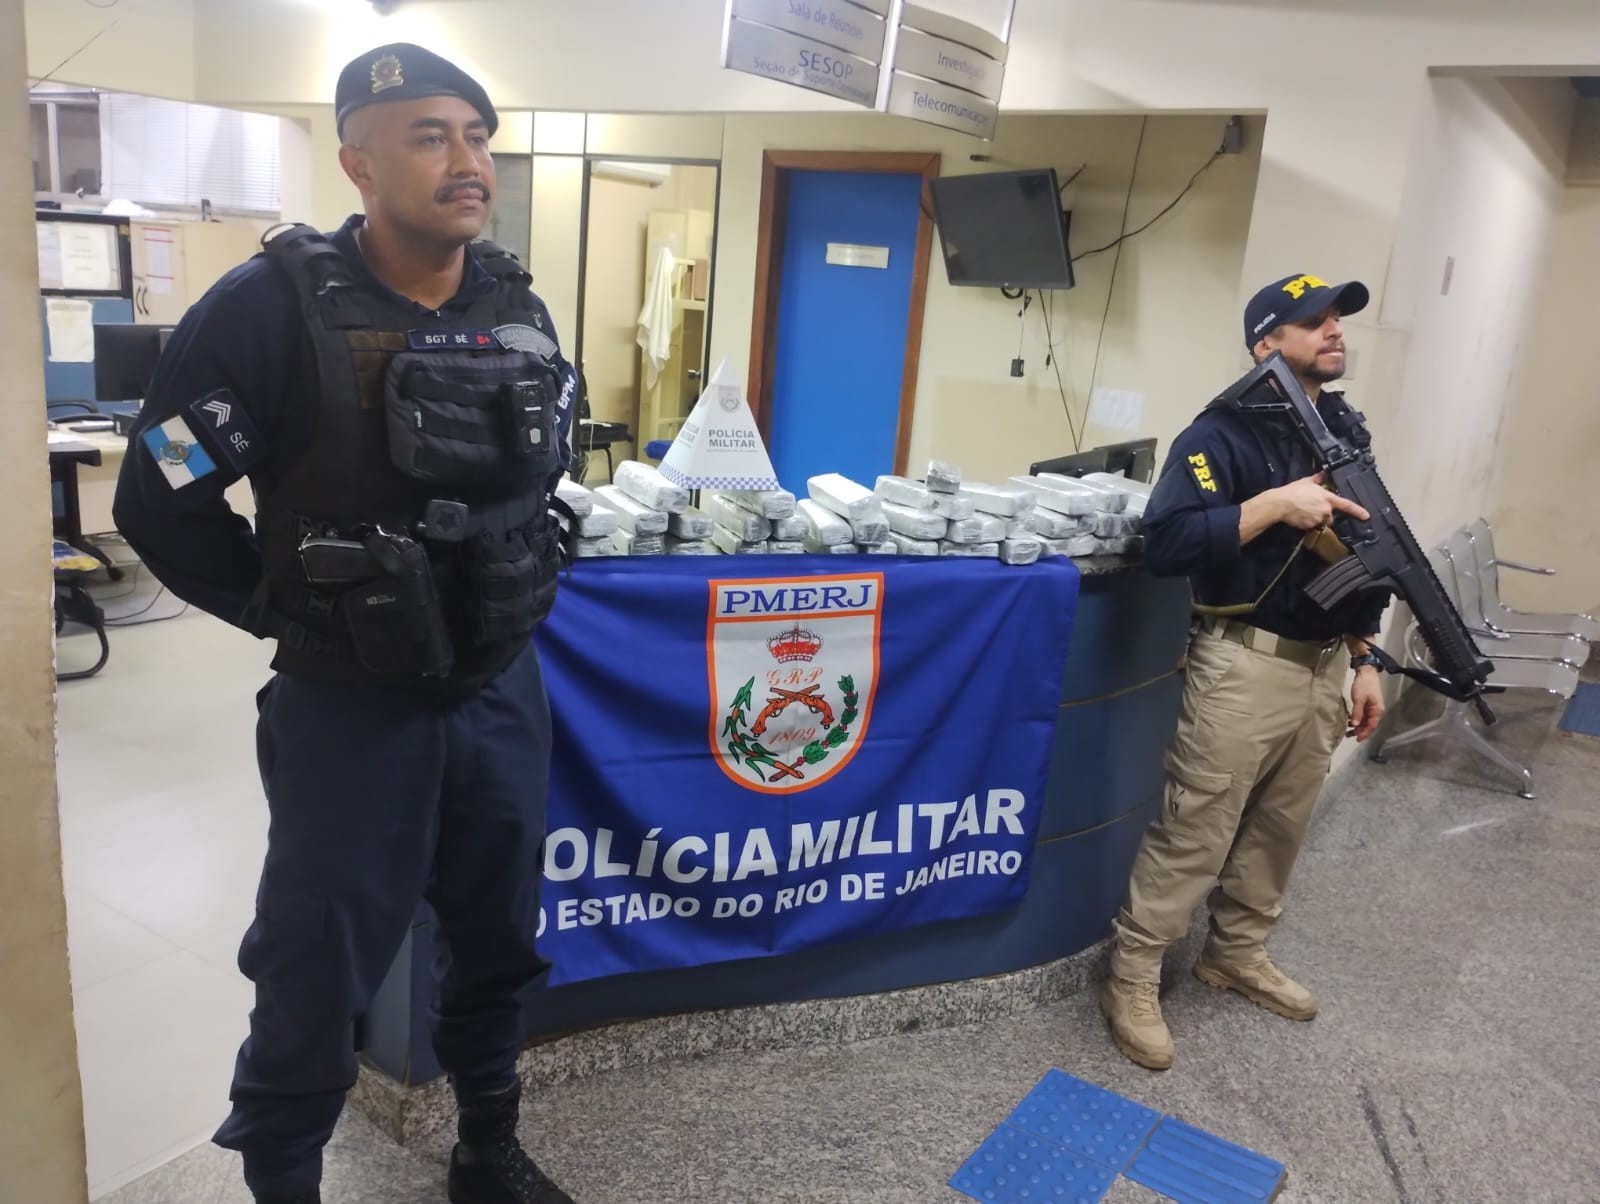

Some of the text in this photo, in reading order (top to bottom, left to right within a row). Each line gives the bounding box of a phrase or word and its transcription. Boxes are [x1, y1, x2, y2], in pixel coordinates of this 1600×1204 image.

[798, 49, 854, 80] SESOP
[424, 334, 448, 344] SGT
[708, 438, 756, 449] MILITAR
[1188, 452, 1217, 493] PRF
[722, 584, 873, 614] PMERJ
[767, 727, 816, 745] 1809
[788, 788, 1026, 872] MILITAR
[557, 893, 701, 931] ESTADO
[712, 893, 764, 918] DO
[774, 879, 828, 914] RIO
[840, 872, 885, 902] DE
[895, 850, 1022, 896] JANEIRO
